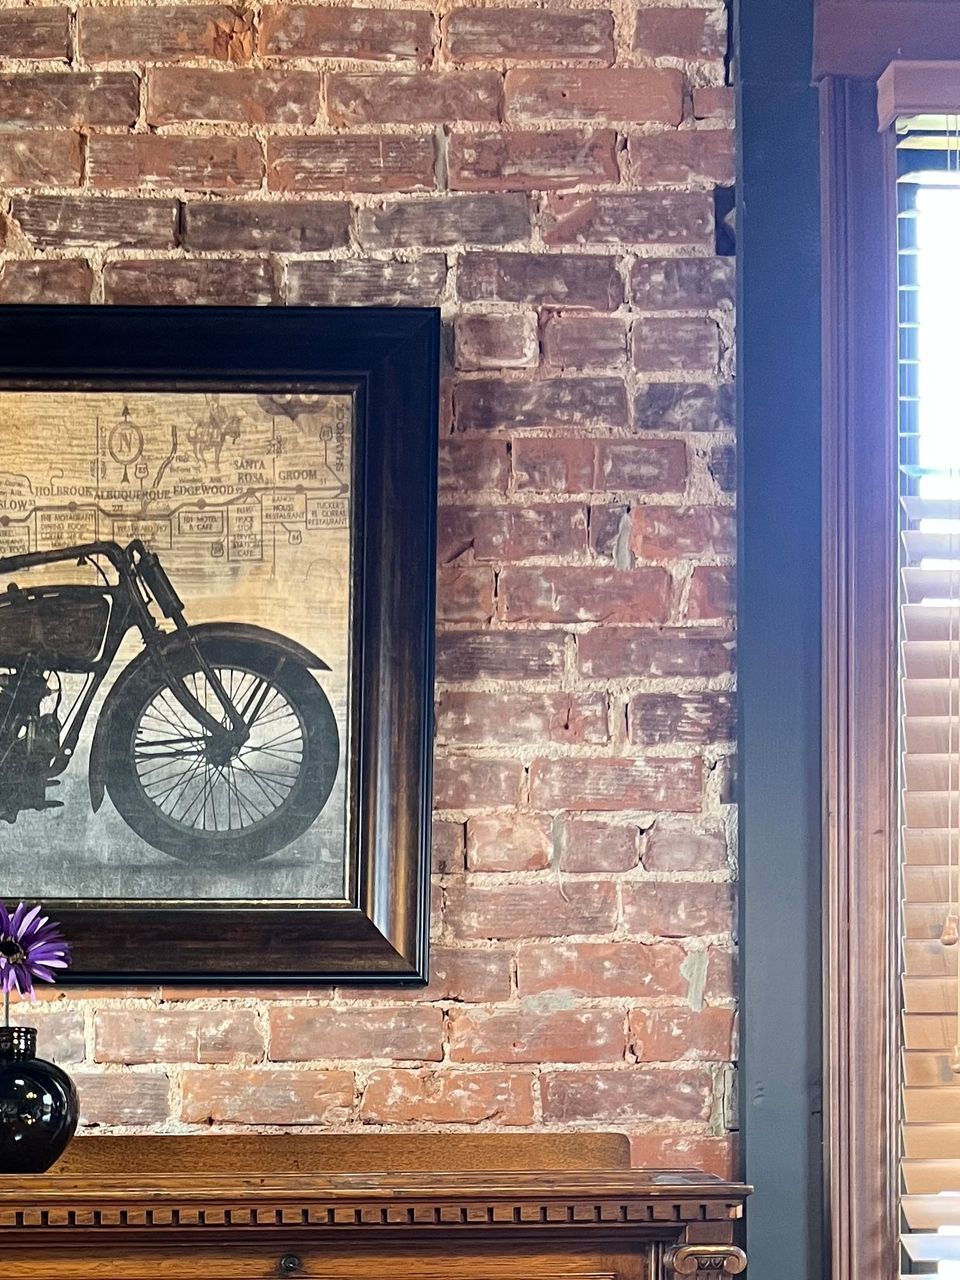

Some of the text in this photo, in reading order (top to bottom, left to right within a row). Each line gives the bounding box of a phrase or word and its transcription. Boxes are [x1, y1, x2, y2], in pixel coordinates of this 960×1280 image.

[119, 432, 132, 452] N
[233, 459, 265, 470] SANTA
[238, 472, 265, 484] ROSA
[278, 470, 317, 481] GROOM
[35, 485, 93, 497] HOLBROOK
[94, 489, 171, 500] ALBUQUERQUE
[173, 484, 234, 496] EDGEWOOD
